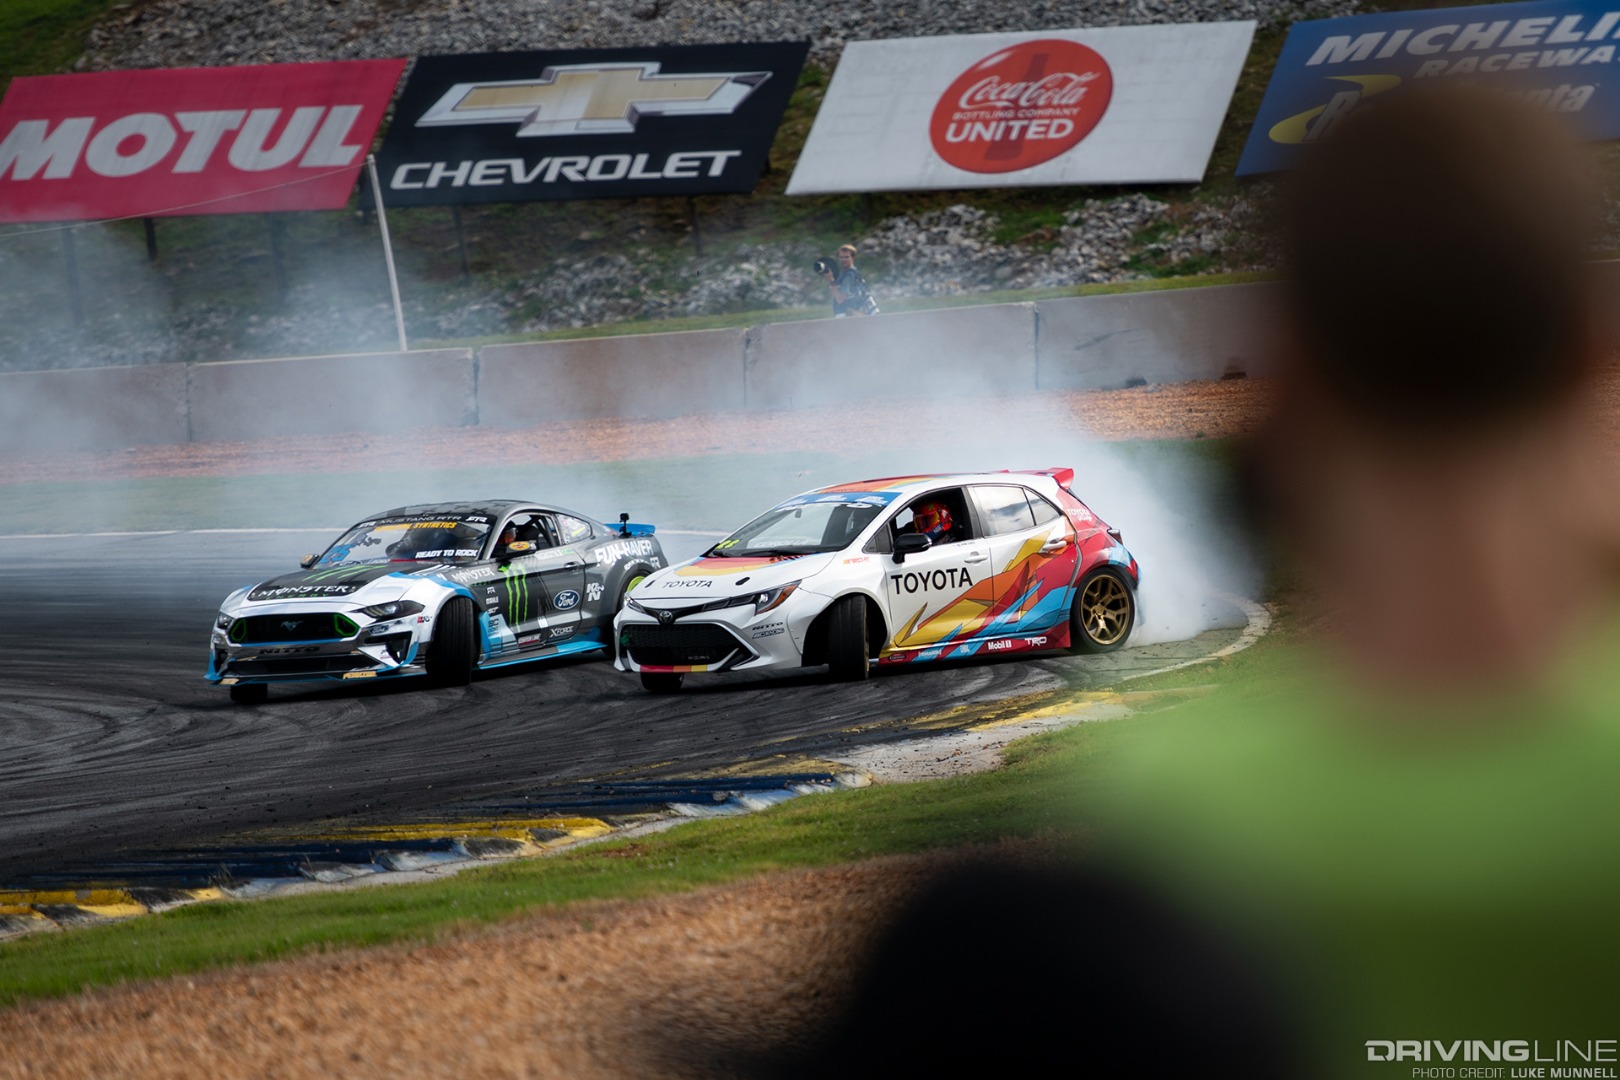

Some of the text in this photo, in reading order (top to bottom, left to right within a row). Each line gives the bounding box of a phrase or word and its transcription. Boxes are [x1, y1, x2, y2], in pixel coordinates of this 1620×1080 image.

[1305, 11, 1620, 66] MICHELI
[1413, 45, 1620, 79] RACEWA
[952, 107, 1080, 120] BOTTLING COMPANY
[945, 118, 1074, 142] UNITED
[0, 104, 363, 181] MOTUL
[390, 150, 742, 189] CHEVROLET
[415, 549, 478, 558] READY TO ROCK
[662, 580, 713, 589] TOYOTA
[891, 567, 973, 595] TOYOTA
[752, 622, 783, 630] NITTO
[987, 640, 1005, 650] Mobil
[1024, 636, 1047, 647] TRD
[259, 646, 320, 655] NITTO
